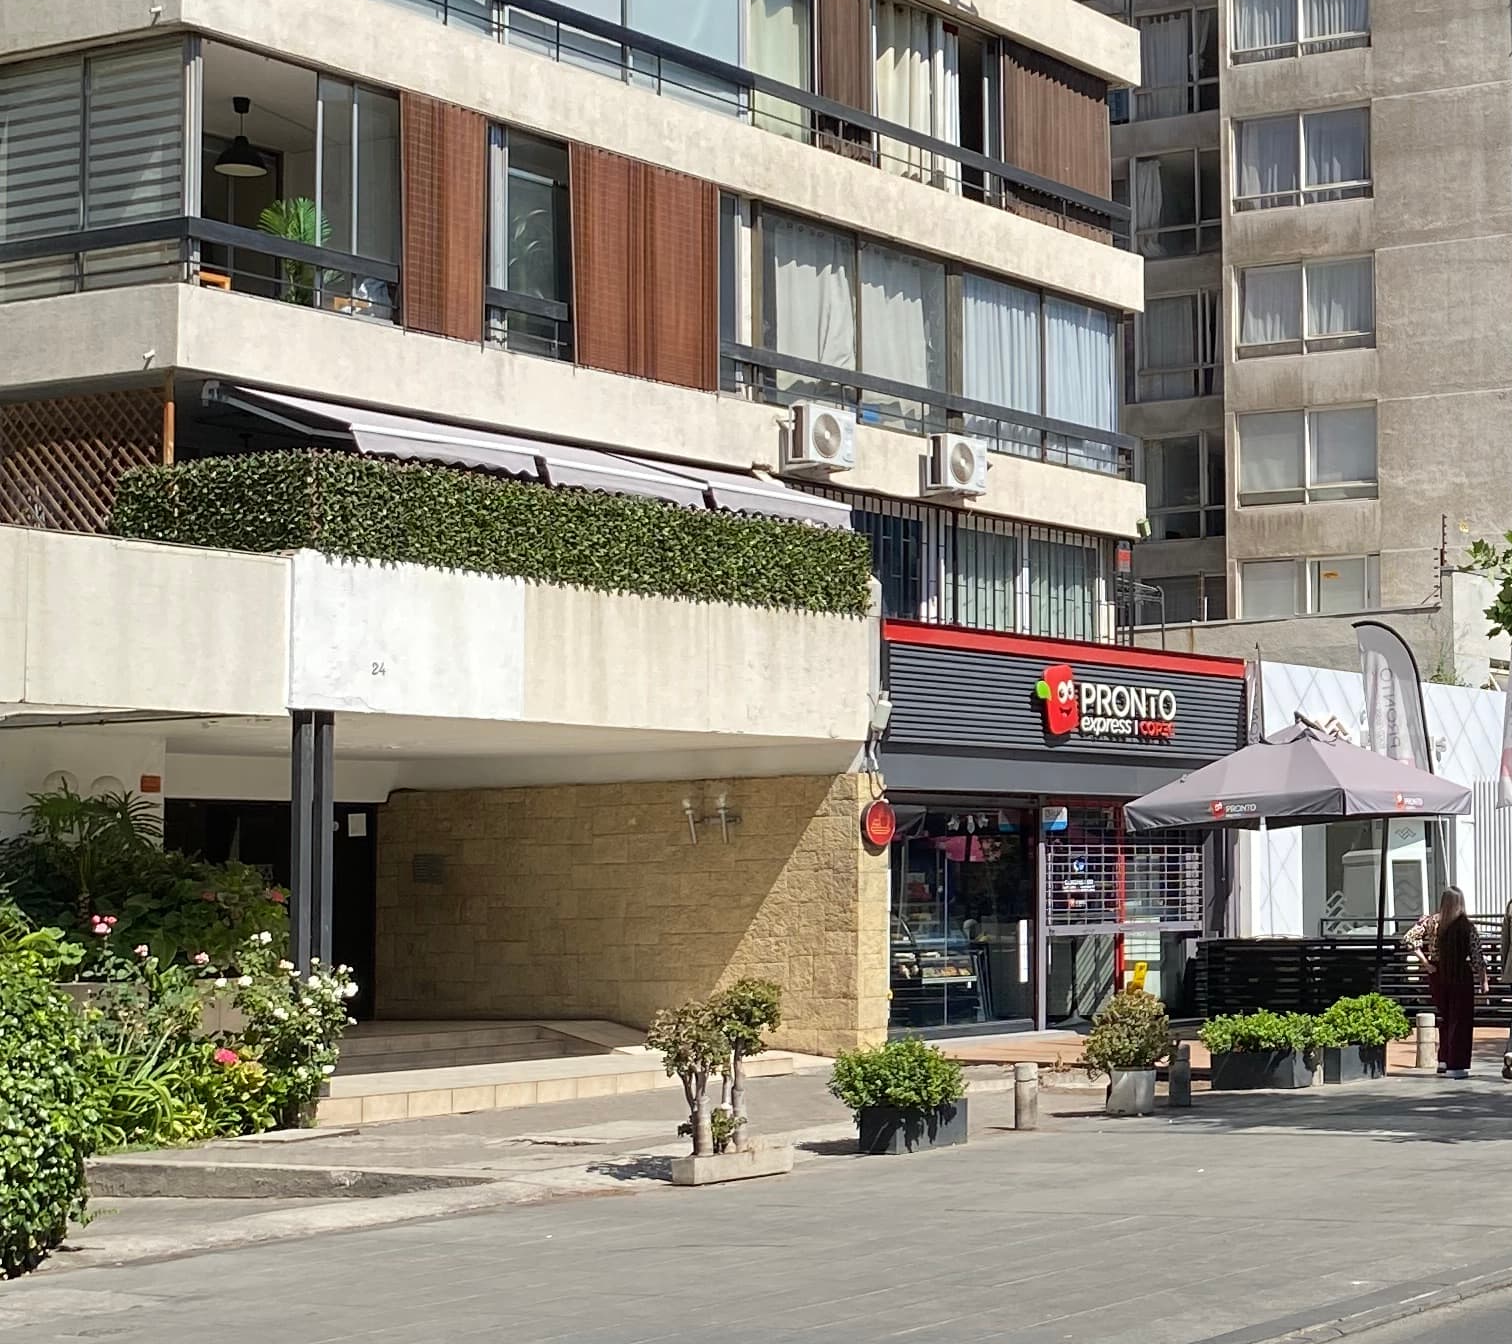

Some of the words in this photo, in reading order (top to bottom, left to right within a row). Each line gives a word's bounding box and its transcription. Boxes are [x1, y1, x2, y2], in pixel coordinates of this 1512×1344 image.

[371, 661, 386, 676] 24
[1081, 682, 1177, 721] PRONTO
[1081, 716, 1132, 736] express
[1225, 803, 1257, 813] PRONTO
